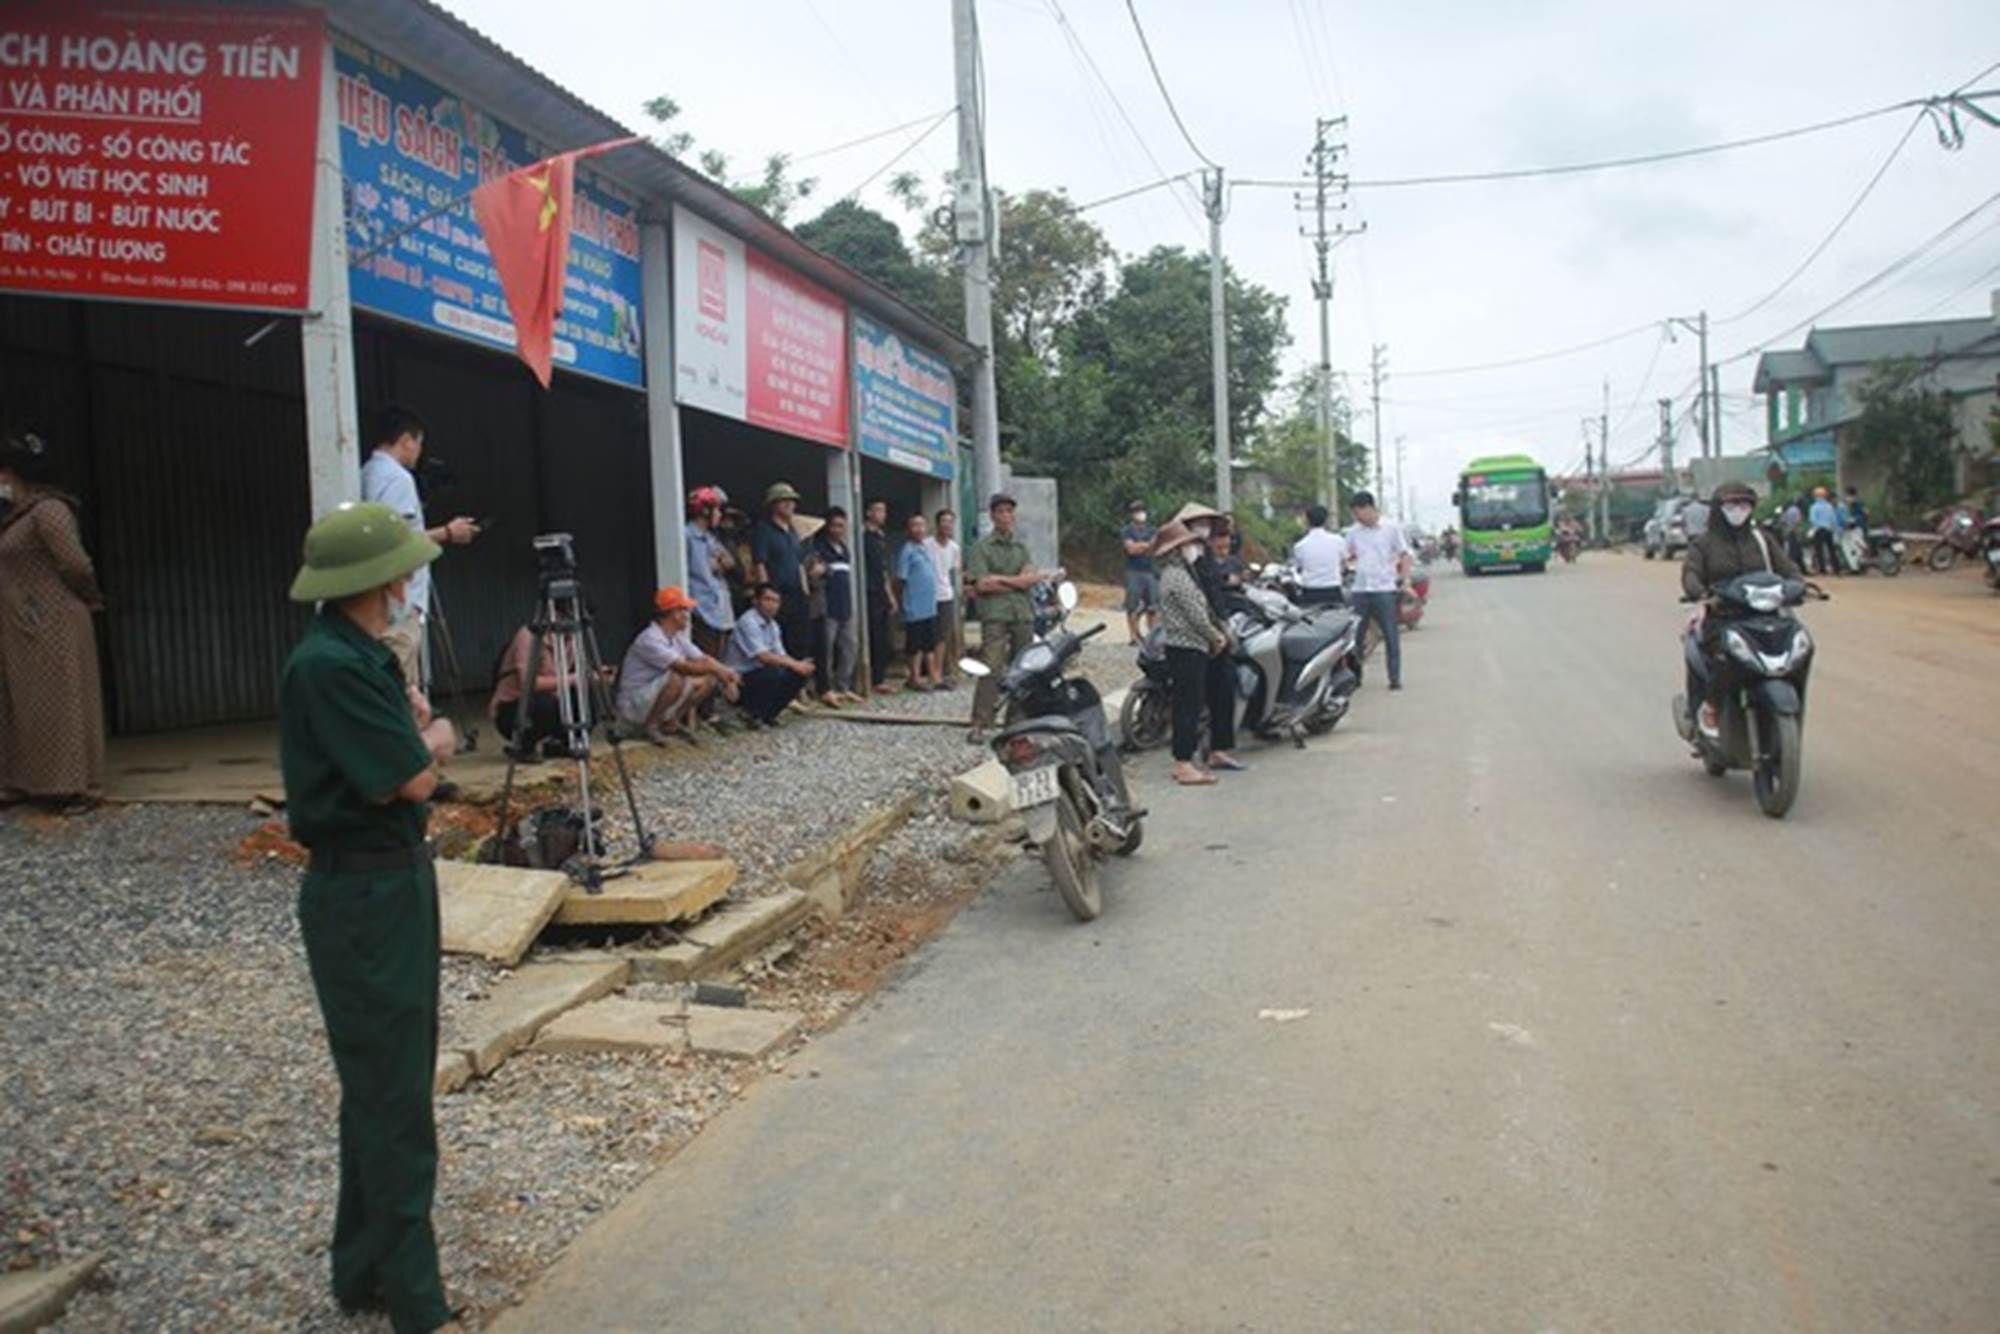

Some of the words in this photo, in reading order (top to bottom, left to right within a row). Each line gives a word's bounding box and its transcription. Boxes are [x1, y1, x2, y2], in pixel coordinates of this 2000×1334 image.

[61, 30, 207, 76] HOÀNG
[218, 33, 299, 80] TIẾN
[9, 73, 48, 109] VÀ
[55, 80, 130, 114] PHÂN
[137, 81, 203, 117] PHỐI
[17, 127, 82, 156] CÔNG
[137, 133, 204, 163] CÔNG
[210, 135, 250, 165] TÁC
[395, 103, 461, 180] SÁCH
[56, 162, 98, 190] VIẾT
[103, 168, 151, 197] HỌC
[156, 172, 208, 197] SINH
[112, 201, 150, 229] BÚT
